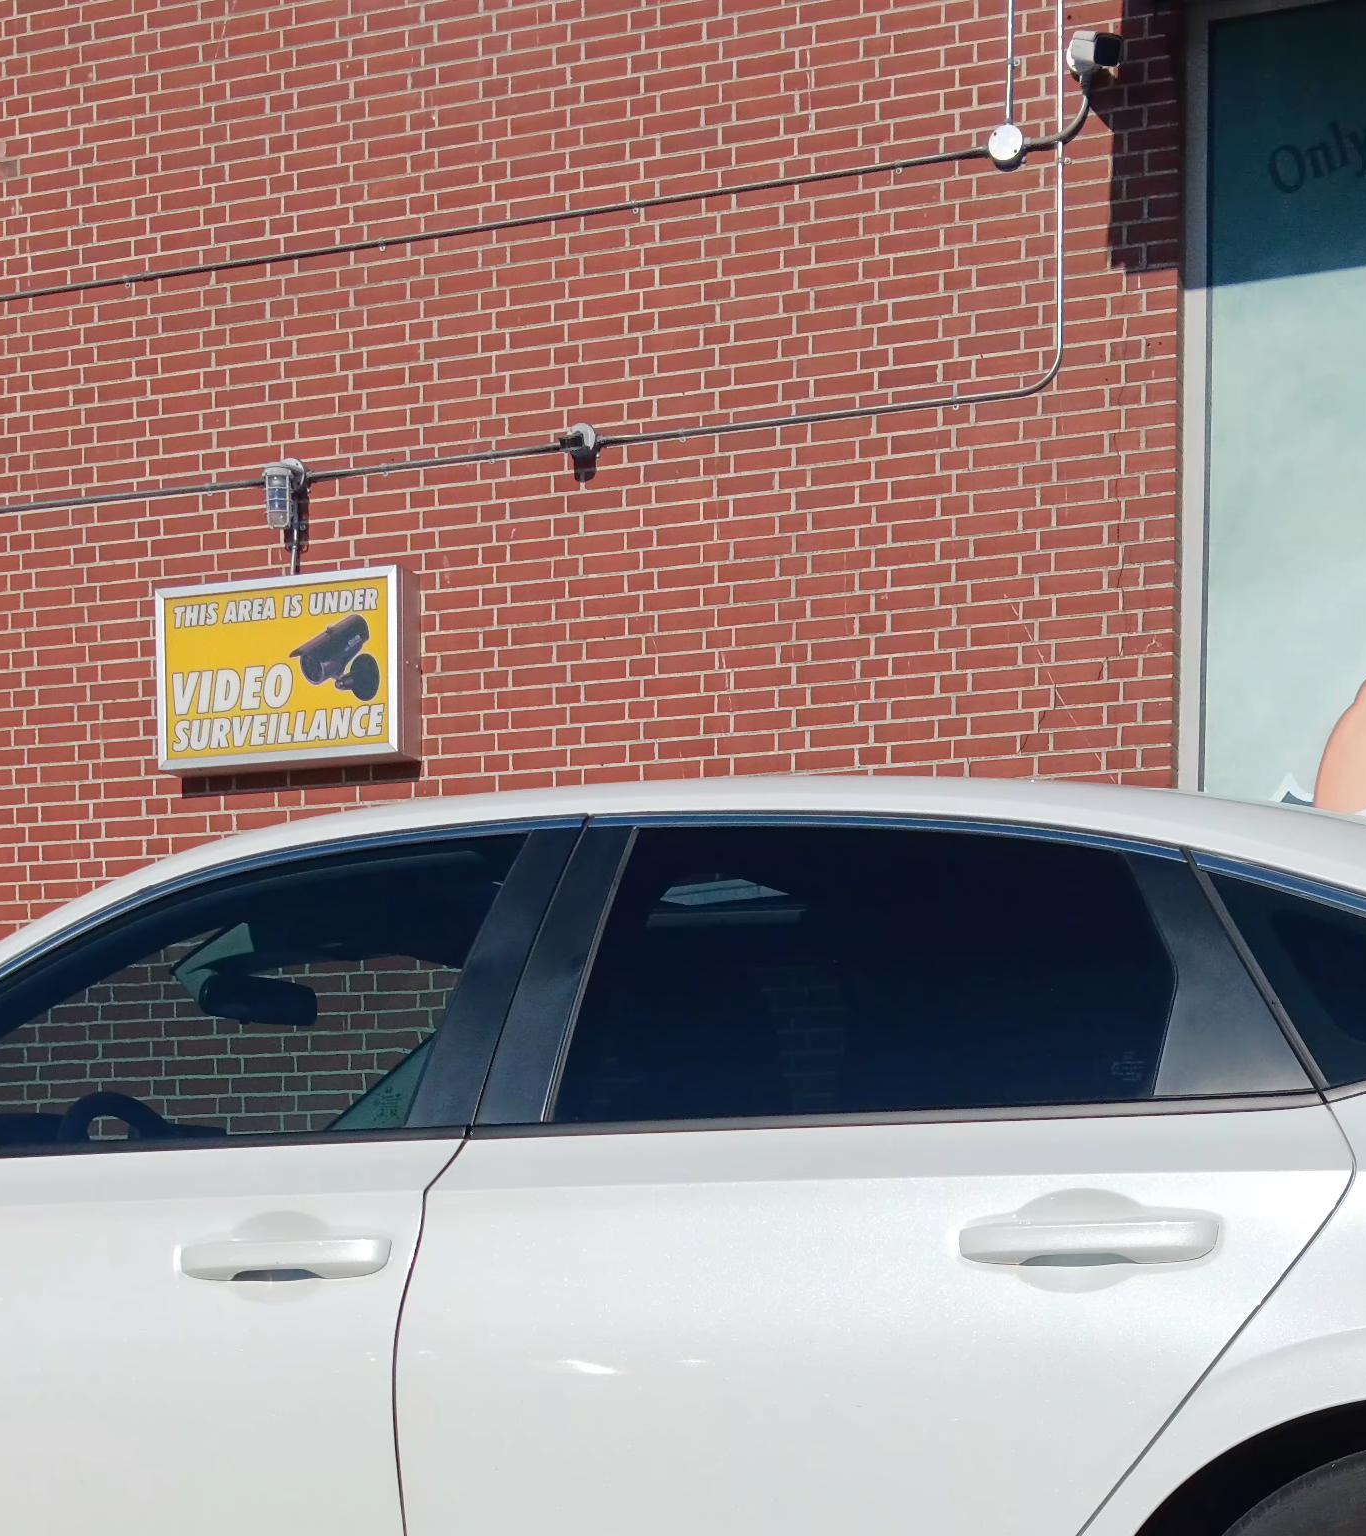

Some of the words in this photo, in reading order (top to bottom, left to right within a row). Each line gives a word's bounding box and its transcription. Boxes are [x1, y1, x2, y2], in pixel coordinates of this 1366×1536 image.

[173, 602, 220, 630] THIS
[222, 597, 276, 625] AREA
[282, 594, 303, 619] IS
[308, 587, 379, 617] UNDER
[171, 662, 294, 717] VIDEO
[172, 703, 385, 753] SURVEILLANCE
